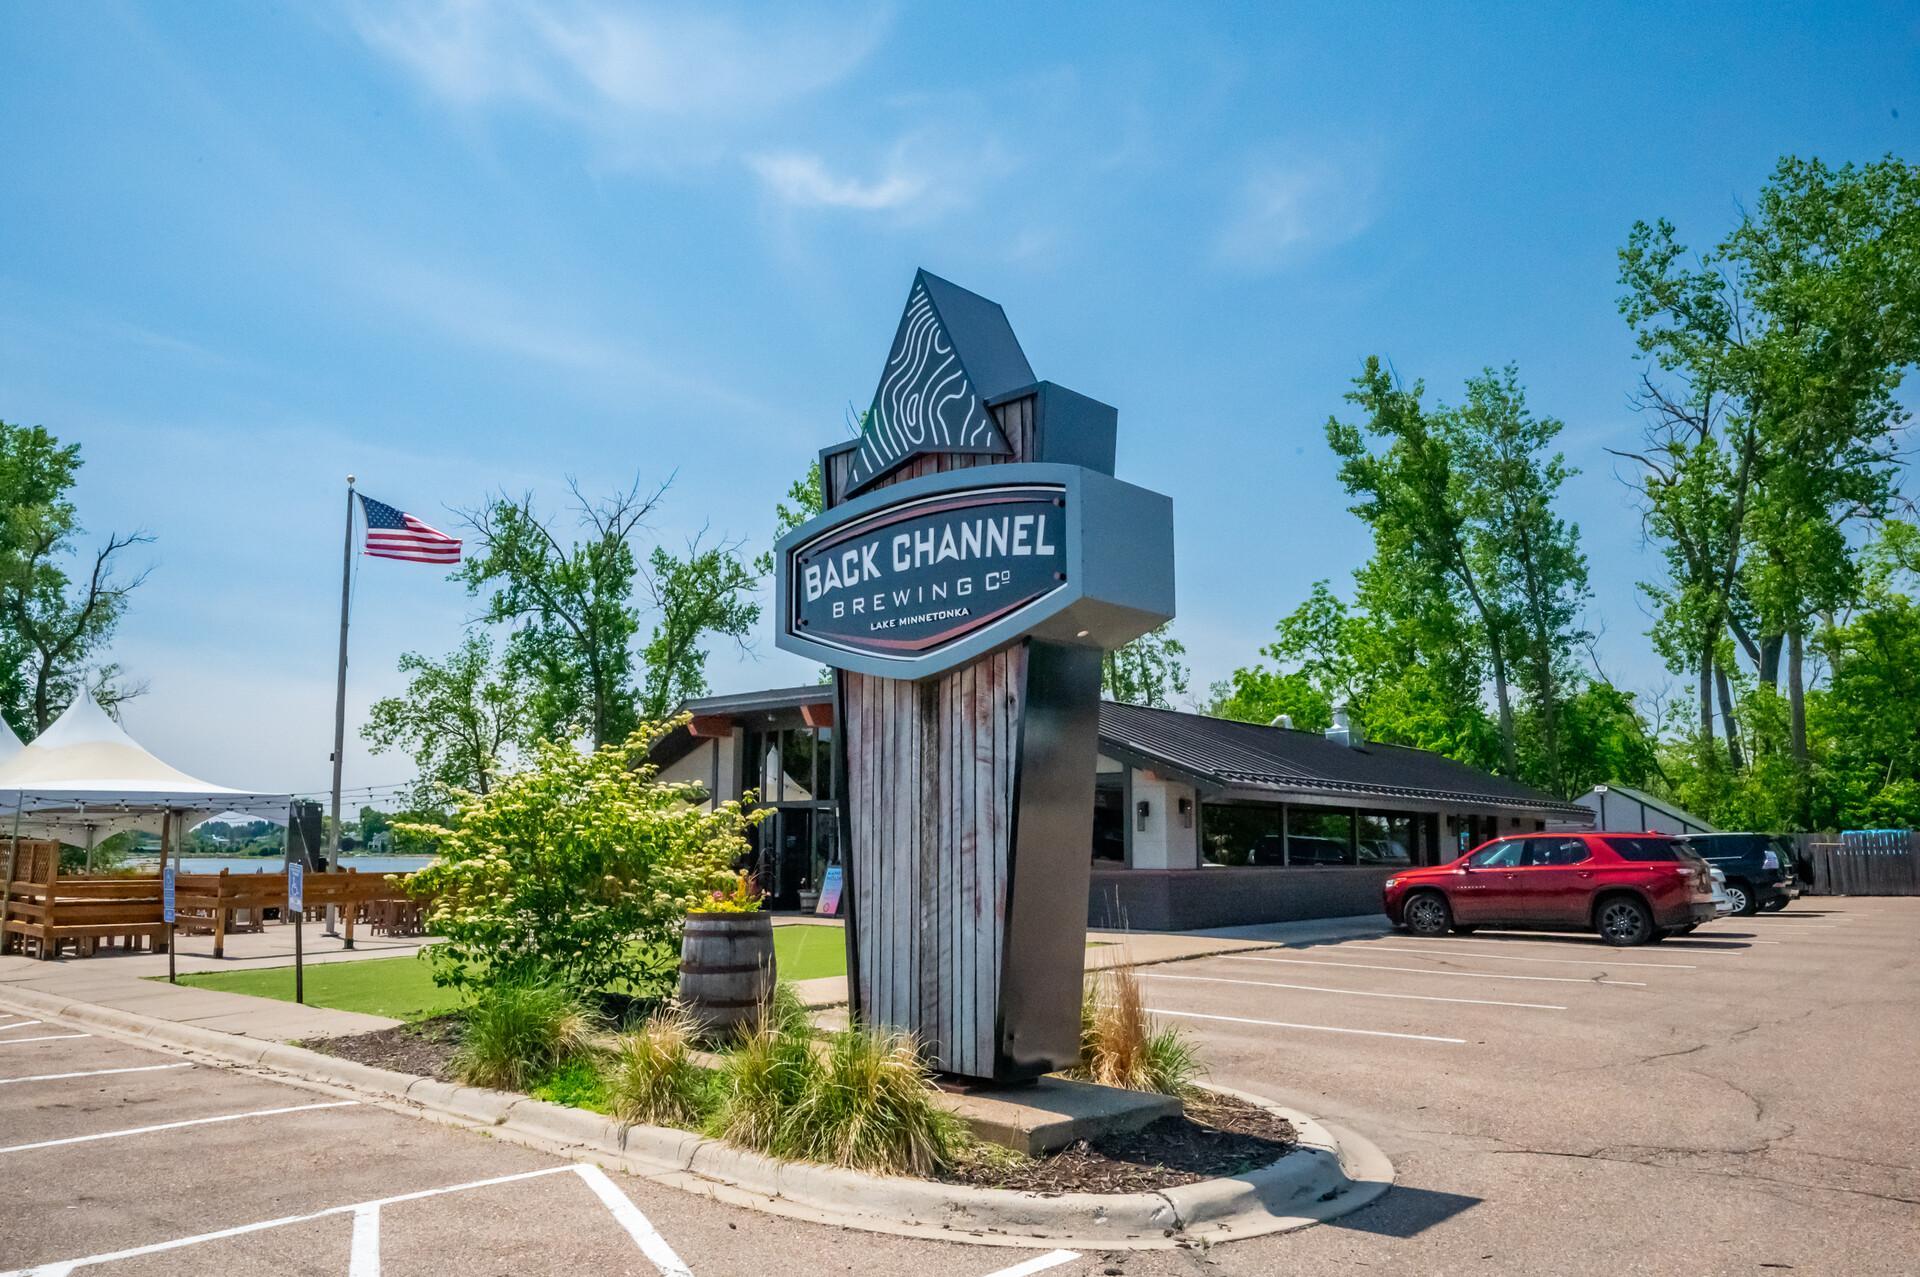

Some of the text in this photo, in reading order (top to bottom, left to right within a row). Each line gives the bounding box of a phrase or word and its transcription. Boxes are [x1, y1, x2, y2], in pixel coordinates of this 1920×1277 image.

[805, 514, 1055, 602] BACK CHANNEL
[833, 577, 973, 618] BREWING
[870, 607, 970, 631] LAKE MINNETONKA
